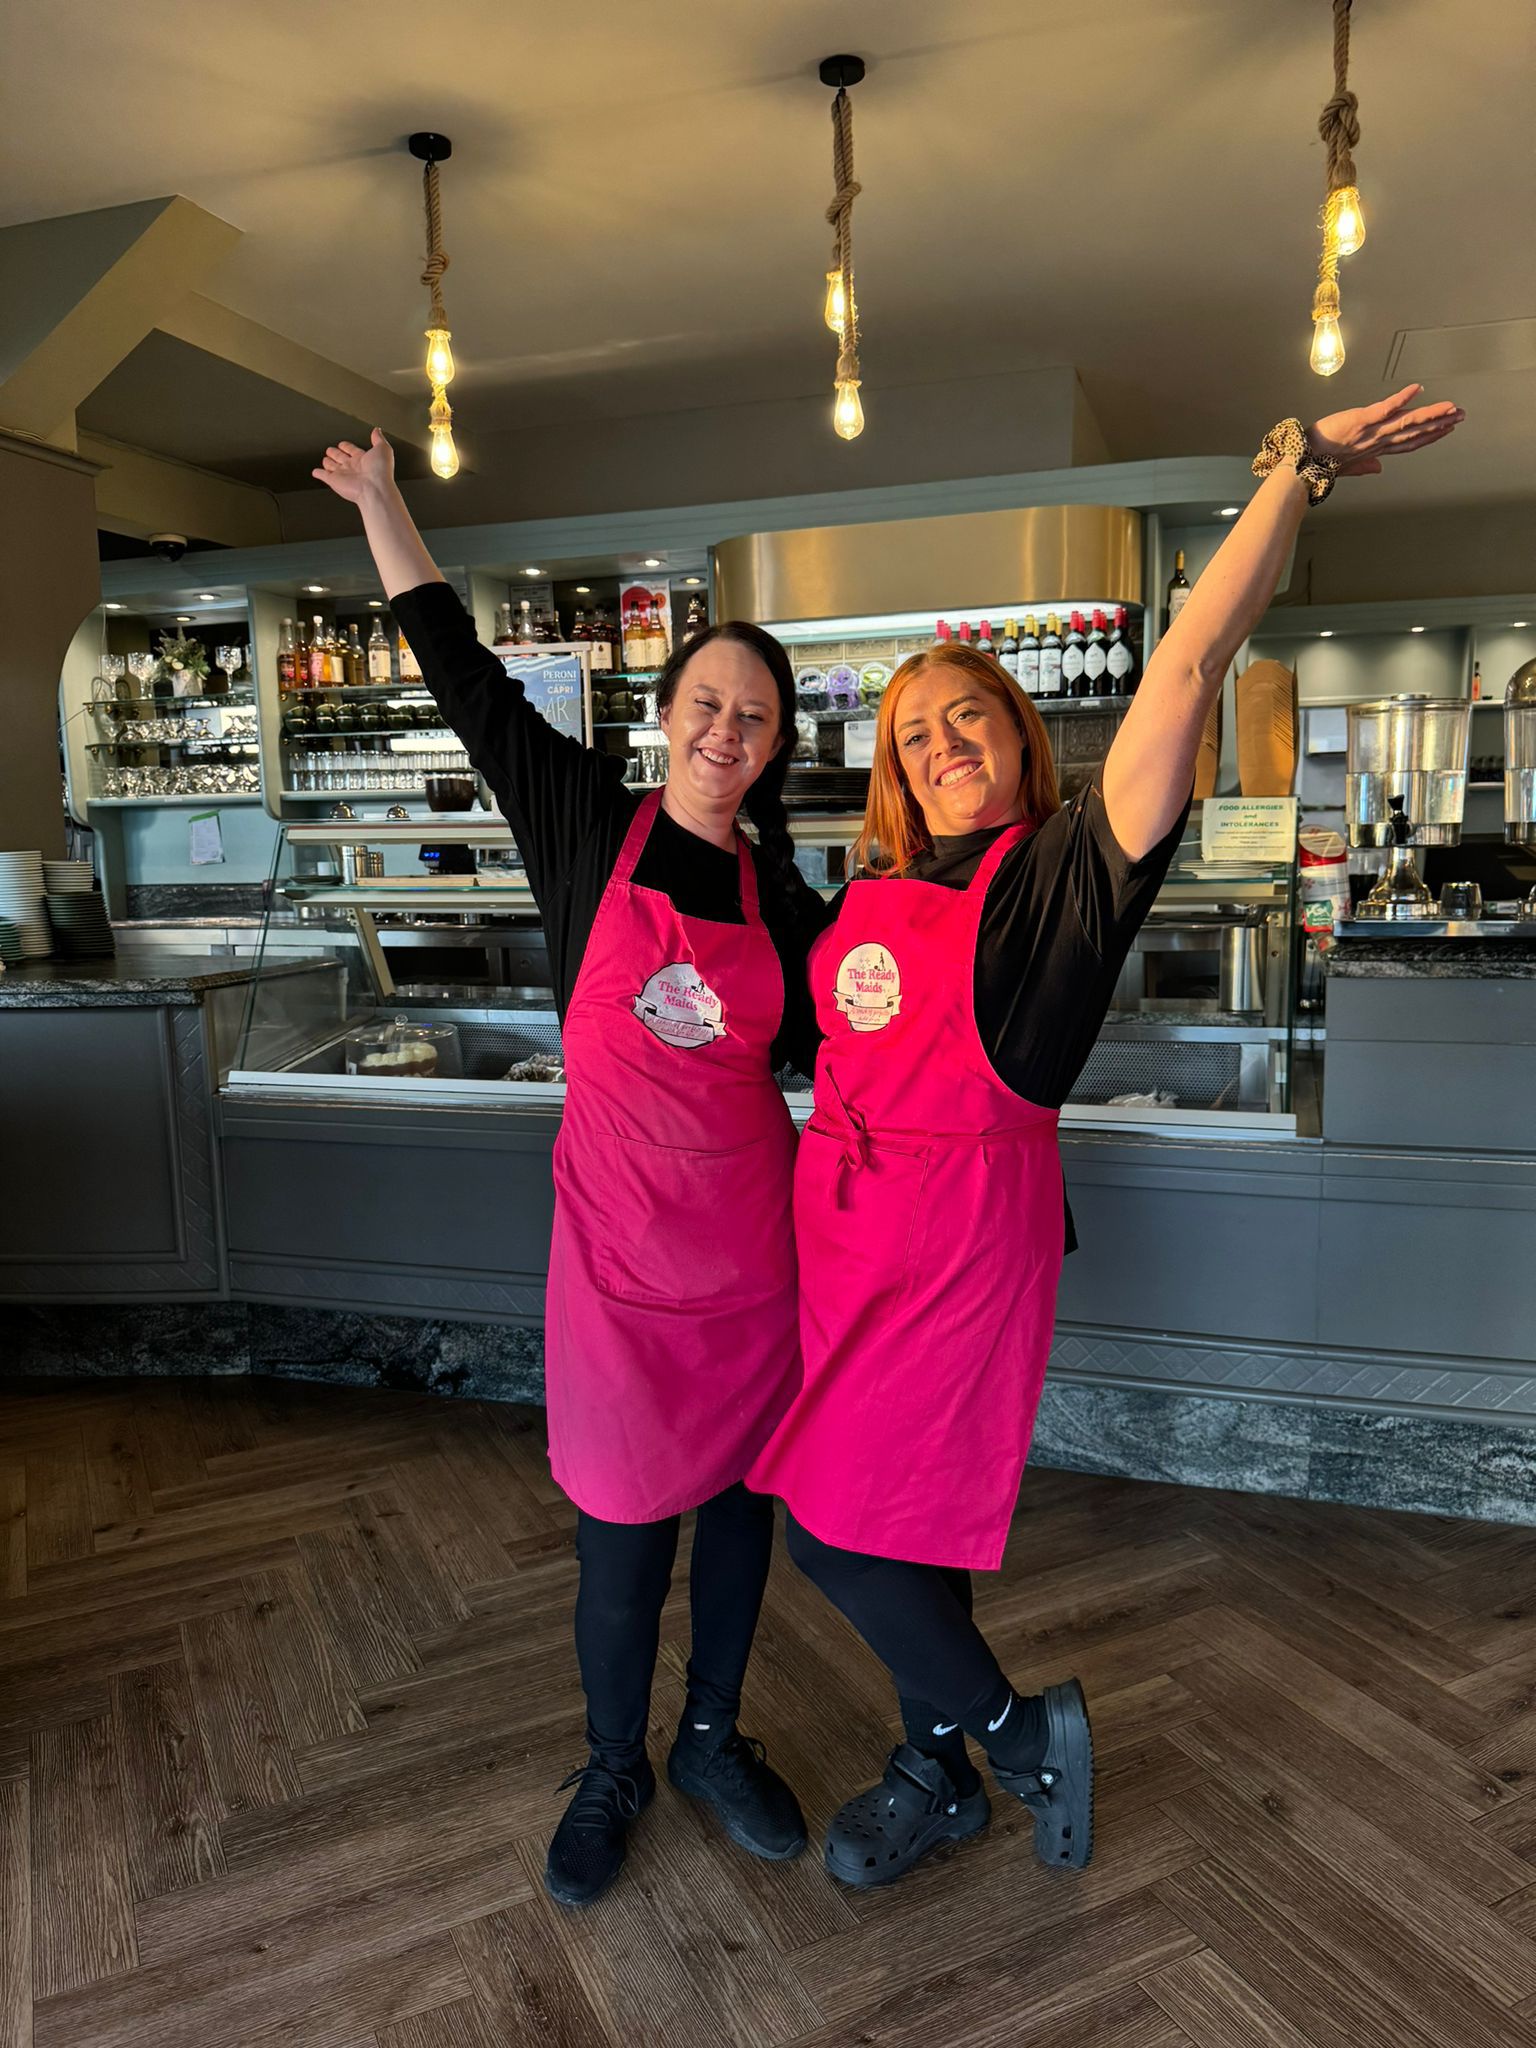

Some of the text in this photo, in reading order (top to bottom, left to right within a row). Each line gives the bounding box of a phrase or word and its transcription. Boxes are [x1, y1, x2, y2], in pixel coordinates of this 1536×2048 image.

[543, 670, 577, 680] PERONI
[547, 686, 574, 695] CAPRI
[1218, 804, 1240, 812] FOOD
[847, 967, 897, 984] The Ready
[855, 980, 883, 994] Maids
[658, 980, 720, 1010] The Ready
[663, 994, 698, 1012] Maids
